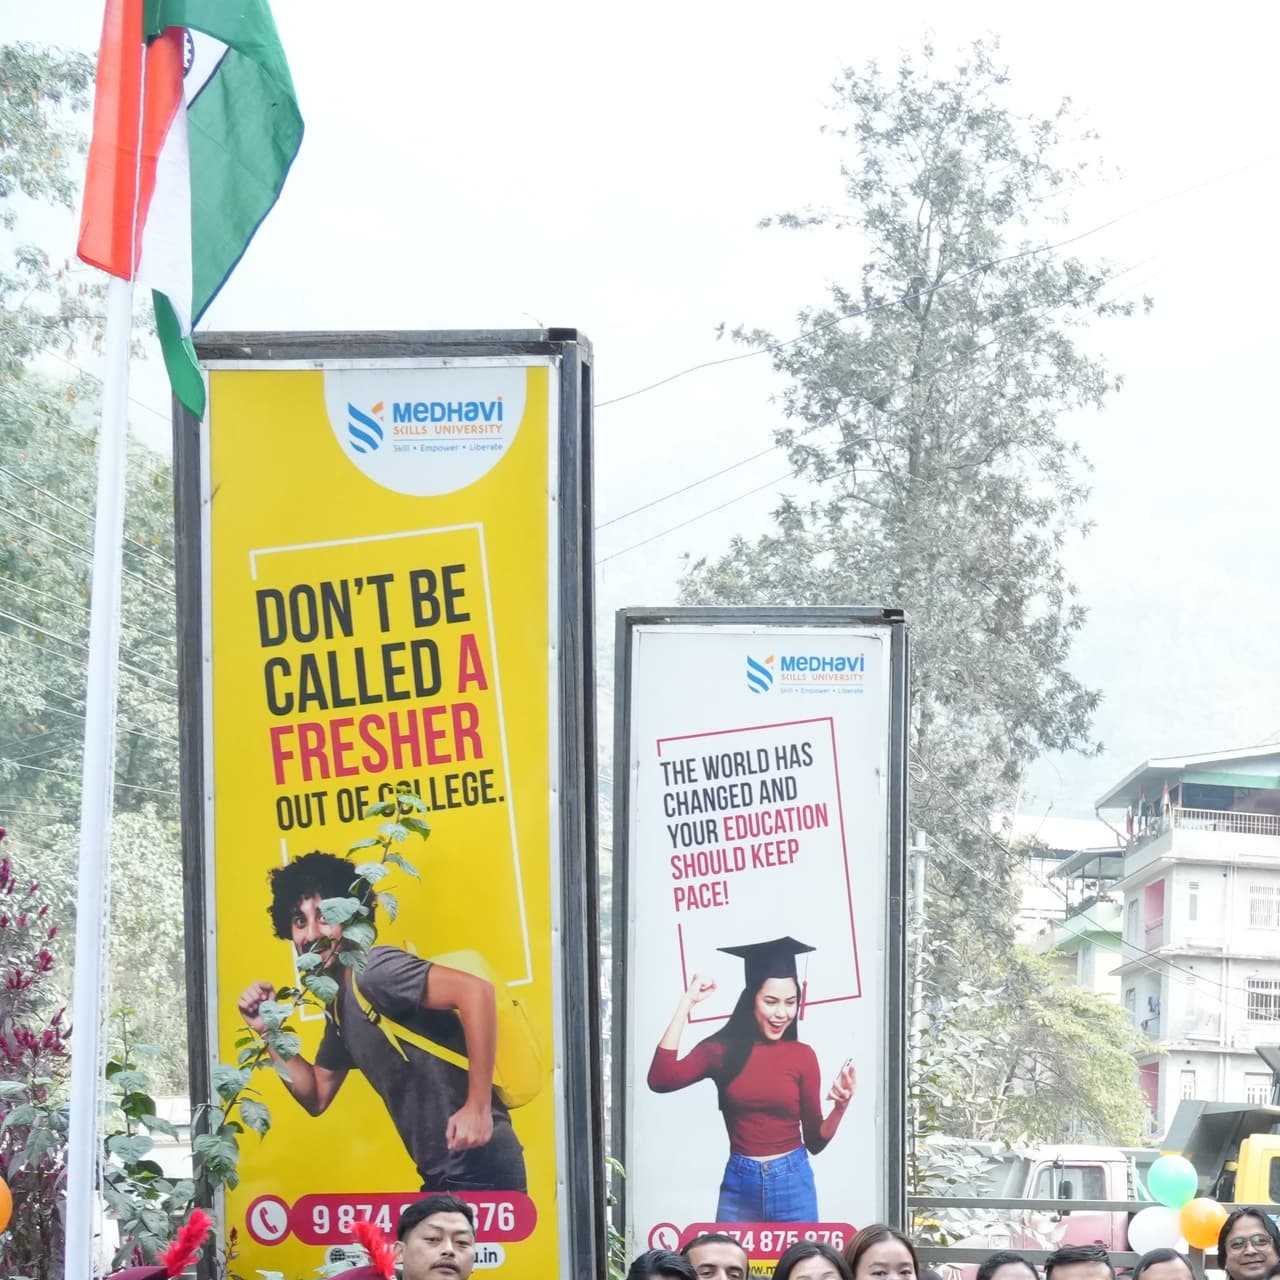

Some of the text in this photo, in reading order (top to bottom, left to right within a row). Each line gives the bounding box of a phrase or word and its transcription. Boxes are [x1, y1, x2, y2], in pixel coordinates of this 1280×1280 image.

[393, 423, 503, 436] SKILLS UNIVERSITY
[420, 443, 459, 455] Empower
[469, 442, 504, 452] Liberate
[256, 564, 471, 648] DON'T BE
[264, 633, 489, 717] CALLED A
[780, 673, 865, 681] SKILLS UNIVERSITY
[269, 702, 484, 785] FRESHER
[660, 742, 814, 786] THE WORLD HAS
[276, 791, 328, 831] OUT
[336, 786, 370, 823] OF
[663, 776, 798, 818] CHANGED AND
[667, 802, 829, 849] YOUR EDUCATION
[670, 838, 800, 880] SHOULD KEEP
[673, 881, 729, 912] PACE!
[312, 1205, 330, 1234] 9
